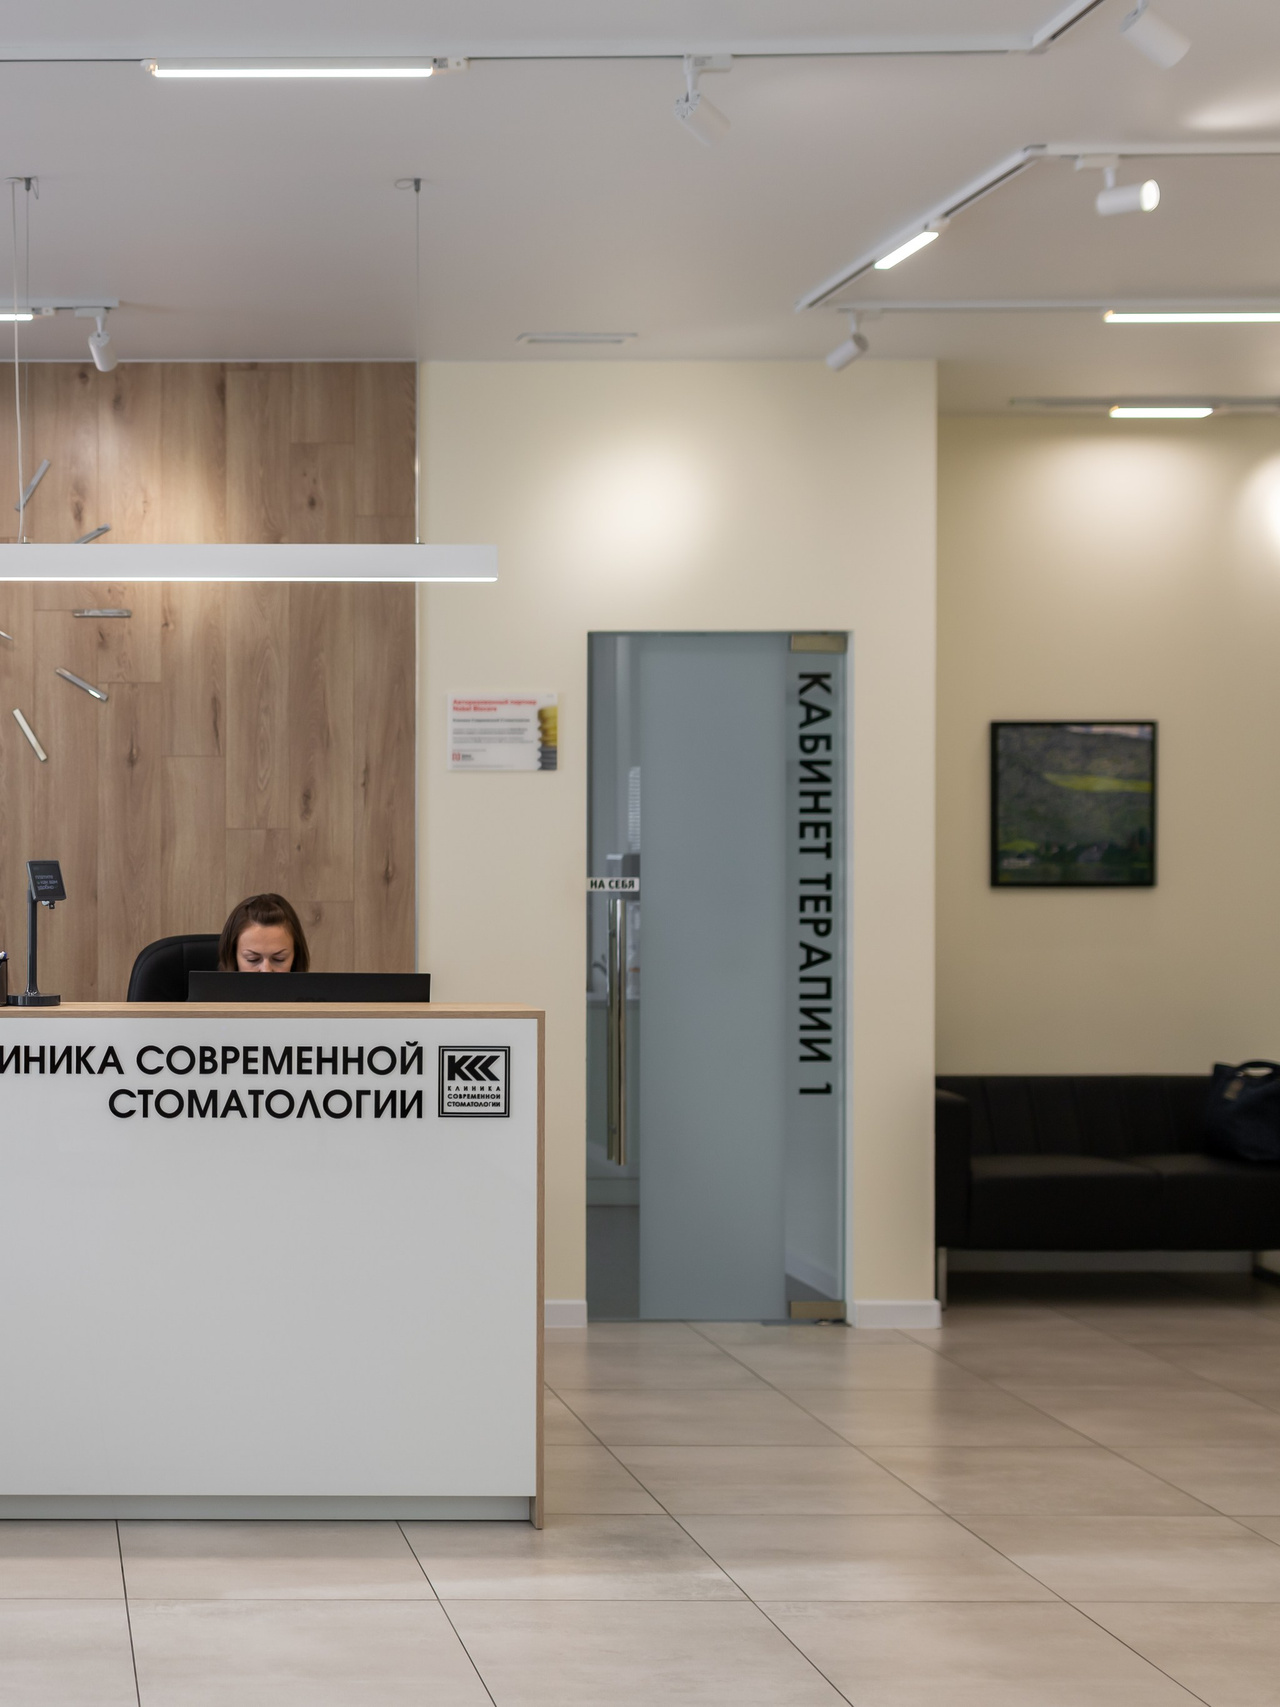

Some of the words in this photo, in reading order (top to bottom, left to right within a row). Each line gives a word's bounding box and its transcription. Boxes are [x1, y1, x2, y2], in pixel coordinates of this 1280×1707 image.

[798, 672, 833, 860] КАБИНЕТ
[590, 880, 605, 889] НА
[608, 880, 635, 889] СЕБЯ
[798, 872, 833, 1063] ТЕРАПИИ
[136, 1040, 424, 1076] СОВРЕМЕННОЙ
[108, 1088, 423, 1120] СТОМАТОЛОГИИ
[798, 1082, 833, 1096] 1
